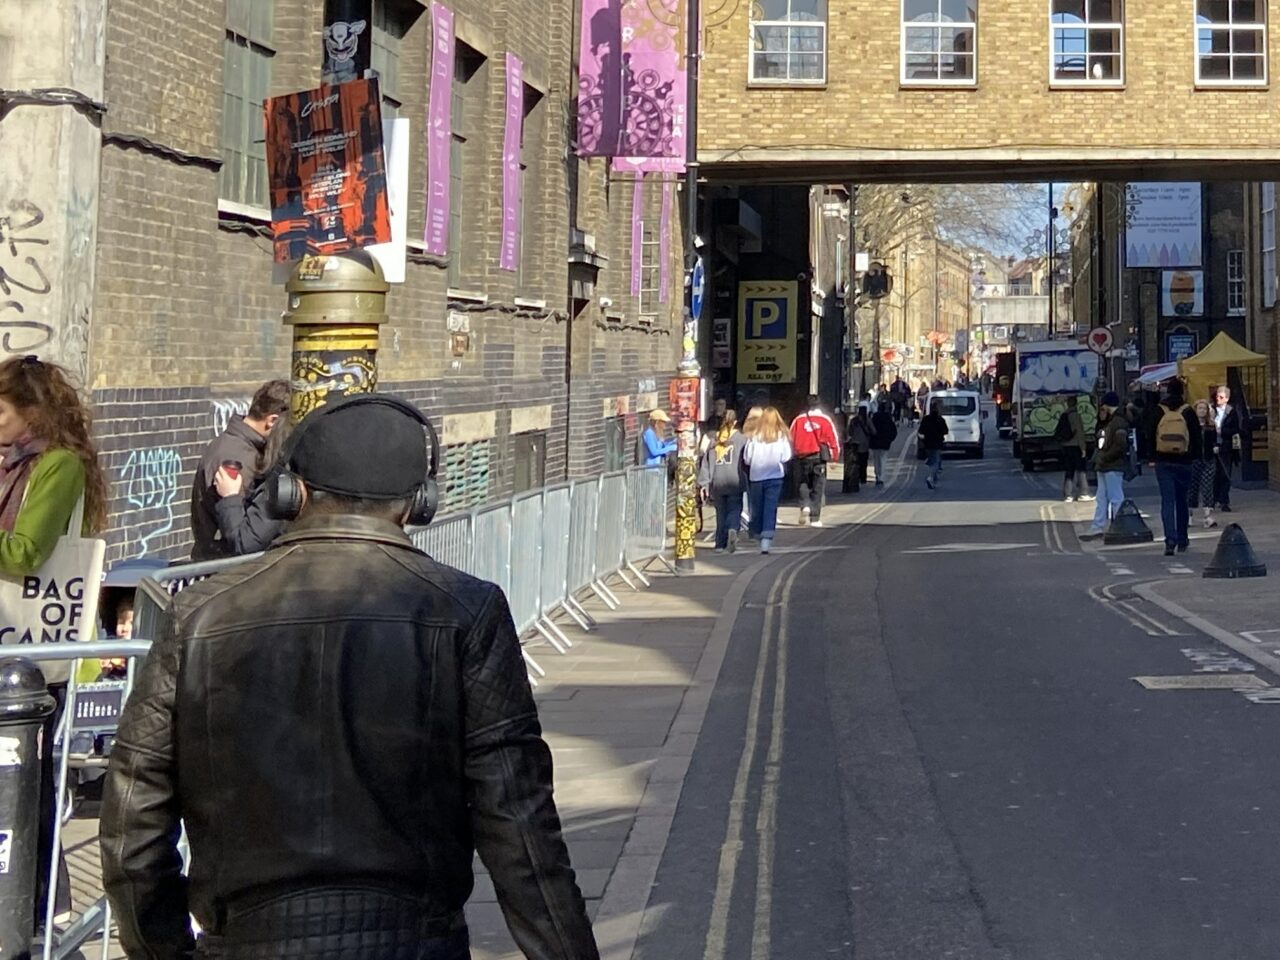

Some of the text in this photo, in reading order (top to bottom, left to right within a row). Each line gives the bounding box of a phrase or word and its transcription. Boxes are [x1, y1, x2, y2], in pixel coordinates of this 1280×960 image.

[752, 301, 780, 337] P
[22, 576, 84, 600] BAG
[40, 603, 83, 626] OF
